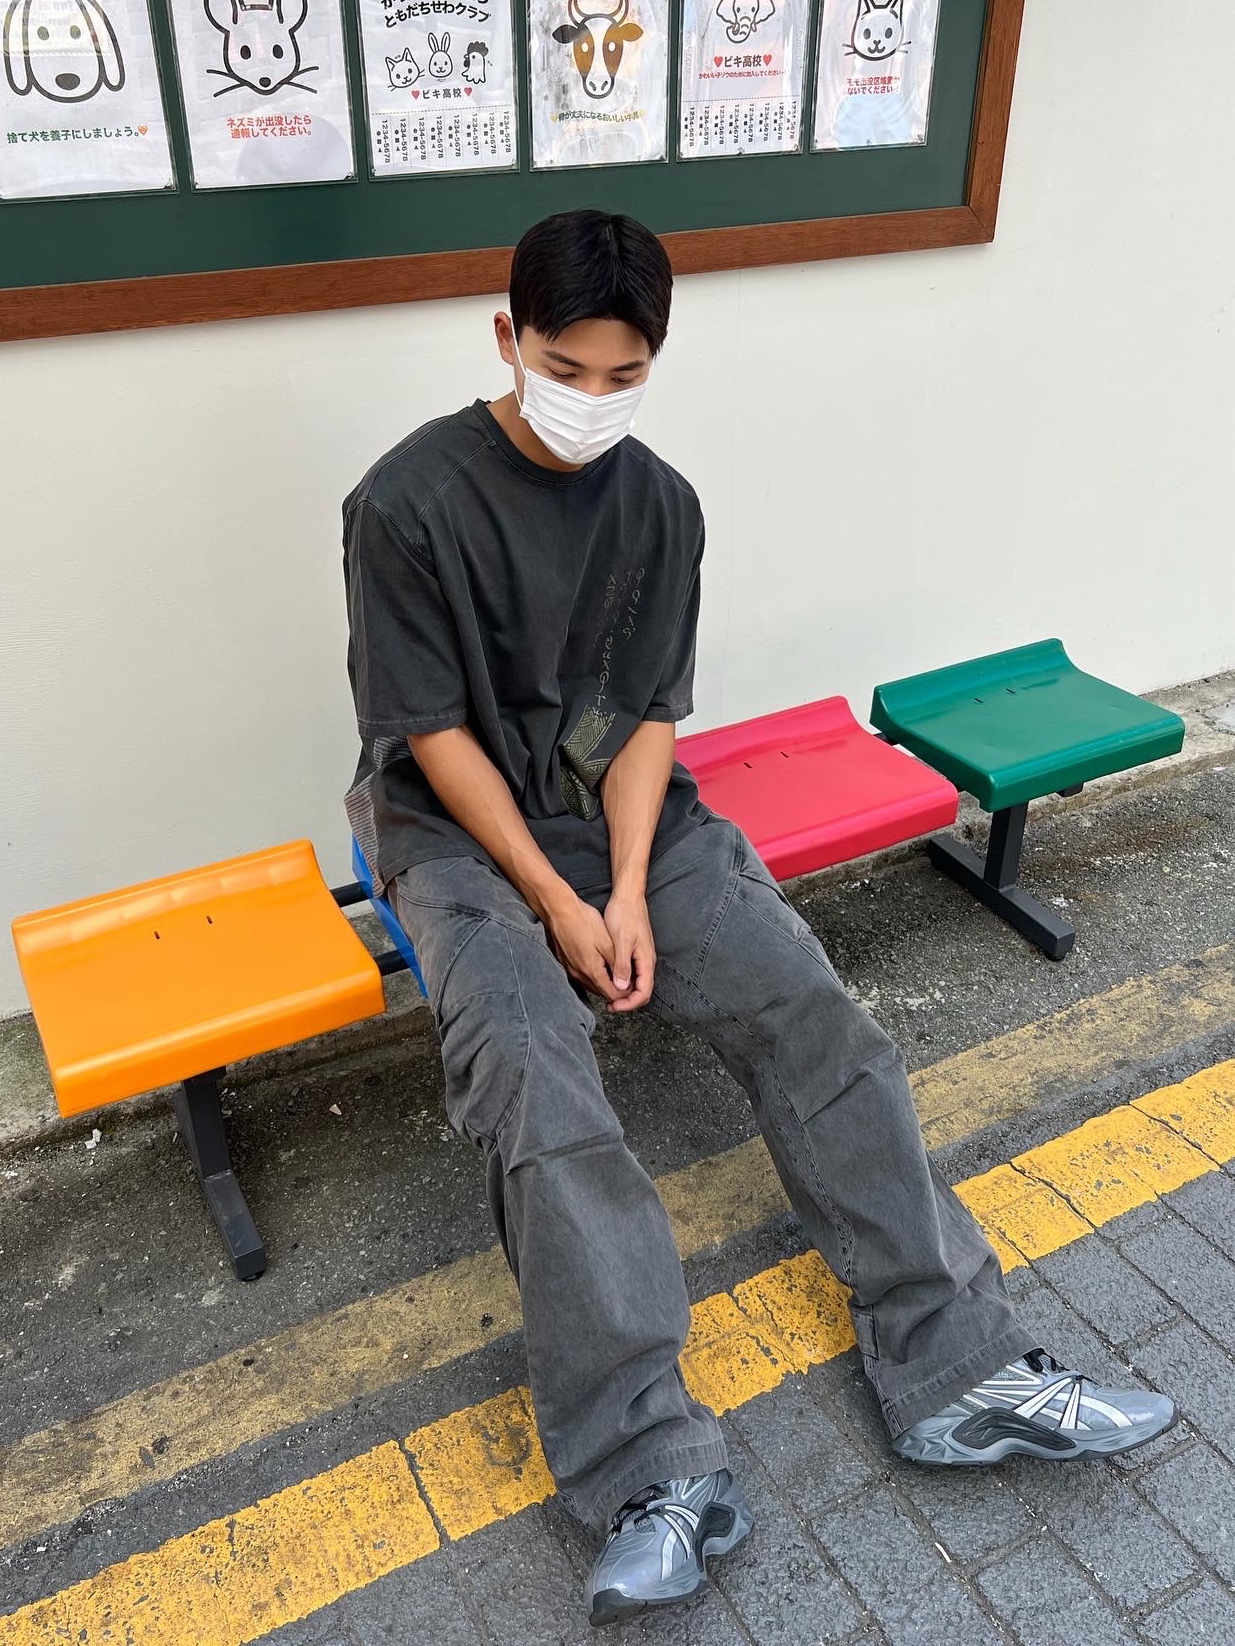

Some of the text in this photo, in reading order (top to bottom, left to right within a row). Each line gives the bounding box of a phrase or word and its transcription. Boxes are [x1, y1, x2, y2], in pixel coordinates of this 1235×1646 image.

[6, 126, 140, 144] 捨て犬を養子にしましょう。
[227, 115, 312, 128] ネズミが出没したら
[382, 119, 391, 164] 1234-5678
[400, 118, 408, 162] 1234-5678
[418, 117, 426, 160] 1234-5678
[436, 115, 444, 159] 1234-5678
[503, 110, 511, 153] 1234-5678
